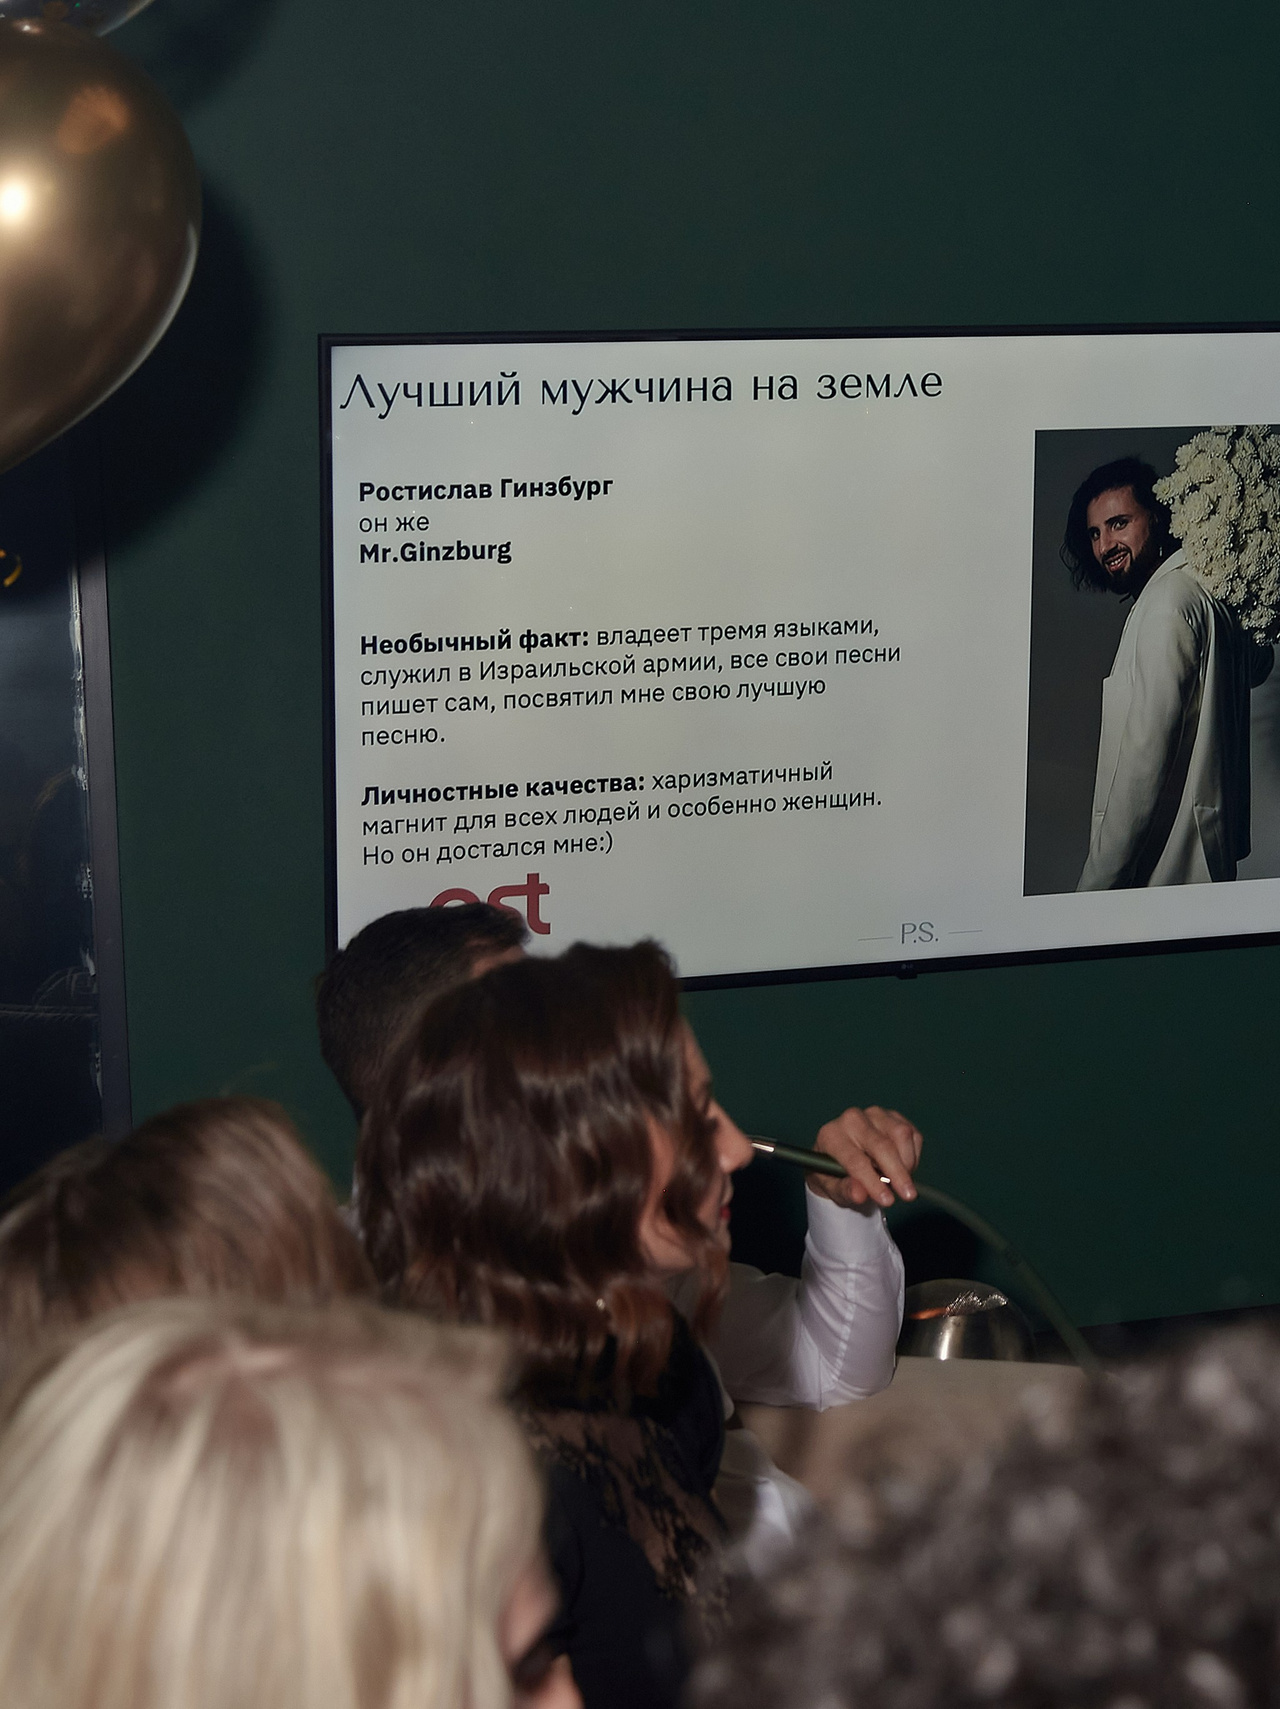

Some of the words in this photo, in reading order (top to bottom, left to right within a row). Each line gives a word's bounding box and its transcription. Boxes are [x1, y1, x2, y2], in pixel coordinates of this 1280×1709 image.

[339, 371, 520, 420] Лучший
[541, 376, 732, 416] мужчина
[753, 374, 798, 401] на
[816, 372, 943, 400] земле
[359, 482, 493, 502] Ростислав
[500, 475, 614, 502] Гинзбург
[359, 516, 388, 533] он
[395, 515, 430, 532] же
[359, 539, 513, 565] Mr.Ginzburg
[360, 627, 512, 656] Необычный
[518, 628, 589, 654] факт:
[597, 626, 693, 648] владеет
[697, 623, 767, 646] тремя
[773, 619, 879, 639] языками,
[360, 667, 451, 690] служил
[459, 666, 472, 682] в
[480, 653, 636, 685] Израильской
[642, 655, 723, 678] армии,
[730, 653, 769, 670] все
[775, 650, 828, 668] свои
[835, 646, 900, 665] песни
[361, 697, 439, 716] пишет
[444, 695, 496, 714] сам,
[503, 689, 613, 710] посвятил
[620, 687, 666, 704] мне
[672, 684, 731, 702] свою
[735, 679, 826, 703] лучшую
[361, 727, 445, 747] песню.
[360, 782, 519, 807] Личностные
[526, 775, 645, 798] качества:
[651, 760, 833, 794] харизматичный
[362, 816, 448, 836] магнит
[453, 813, 496, 835] для
[504, 809, 558, 828] всех
[562, 800, 640, 826] людей
[647, 804, 660, 820] и
[667, 795, 777, 818] особенно
[782, 791, 882, 812] женщин.
[363, 845, 394, 866] Но
[401, 846, 430, 864] он
[436, 840, 545, 865] достался
[901, 921, 939, 944] P.S.
